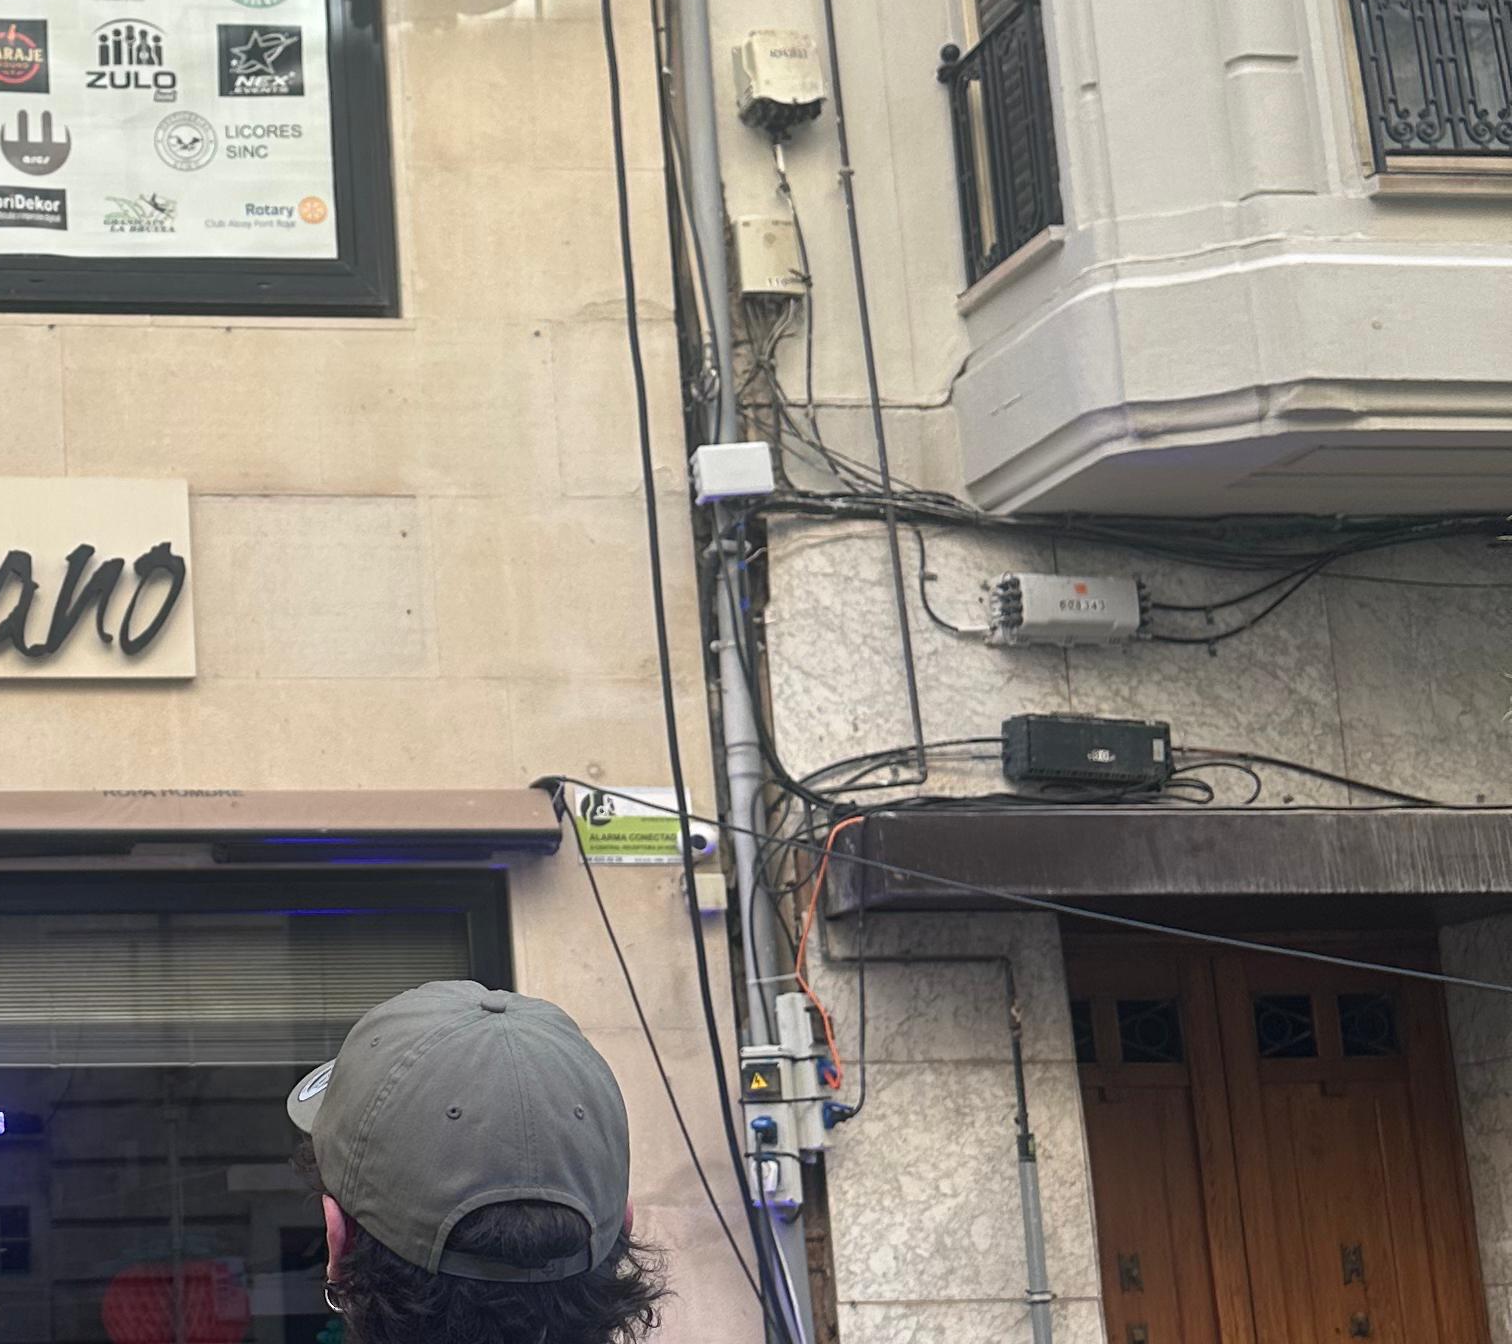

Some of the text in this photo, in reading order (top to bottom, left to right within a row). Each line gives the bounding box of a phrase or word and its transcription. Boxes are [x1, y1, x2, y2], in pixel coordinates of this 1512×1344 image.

[86, 71, 177, 89] ZULO
[225, 124, 303, 139] LICORES
[226, 145, 269, 159] SINC
[245, 203, 293, 217] Rotary
[589, 832, 677, 842] ALARMA CONECTAD
